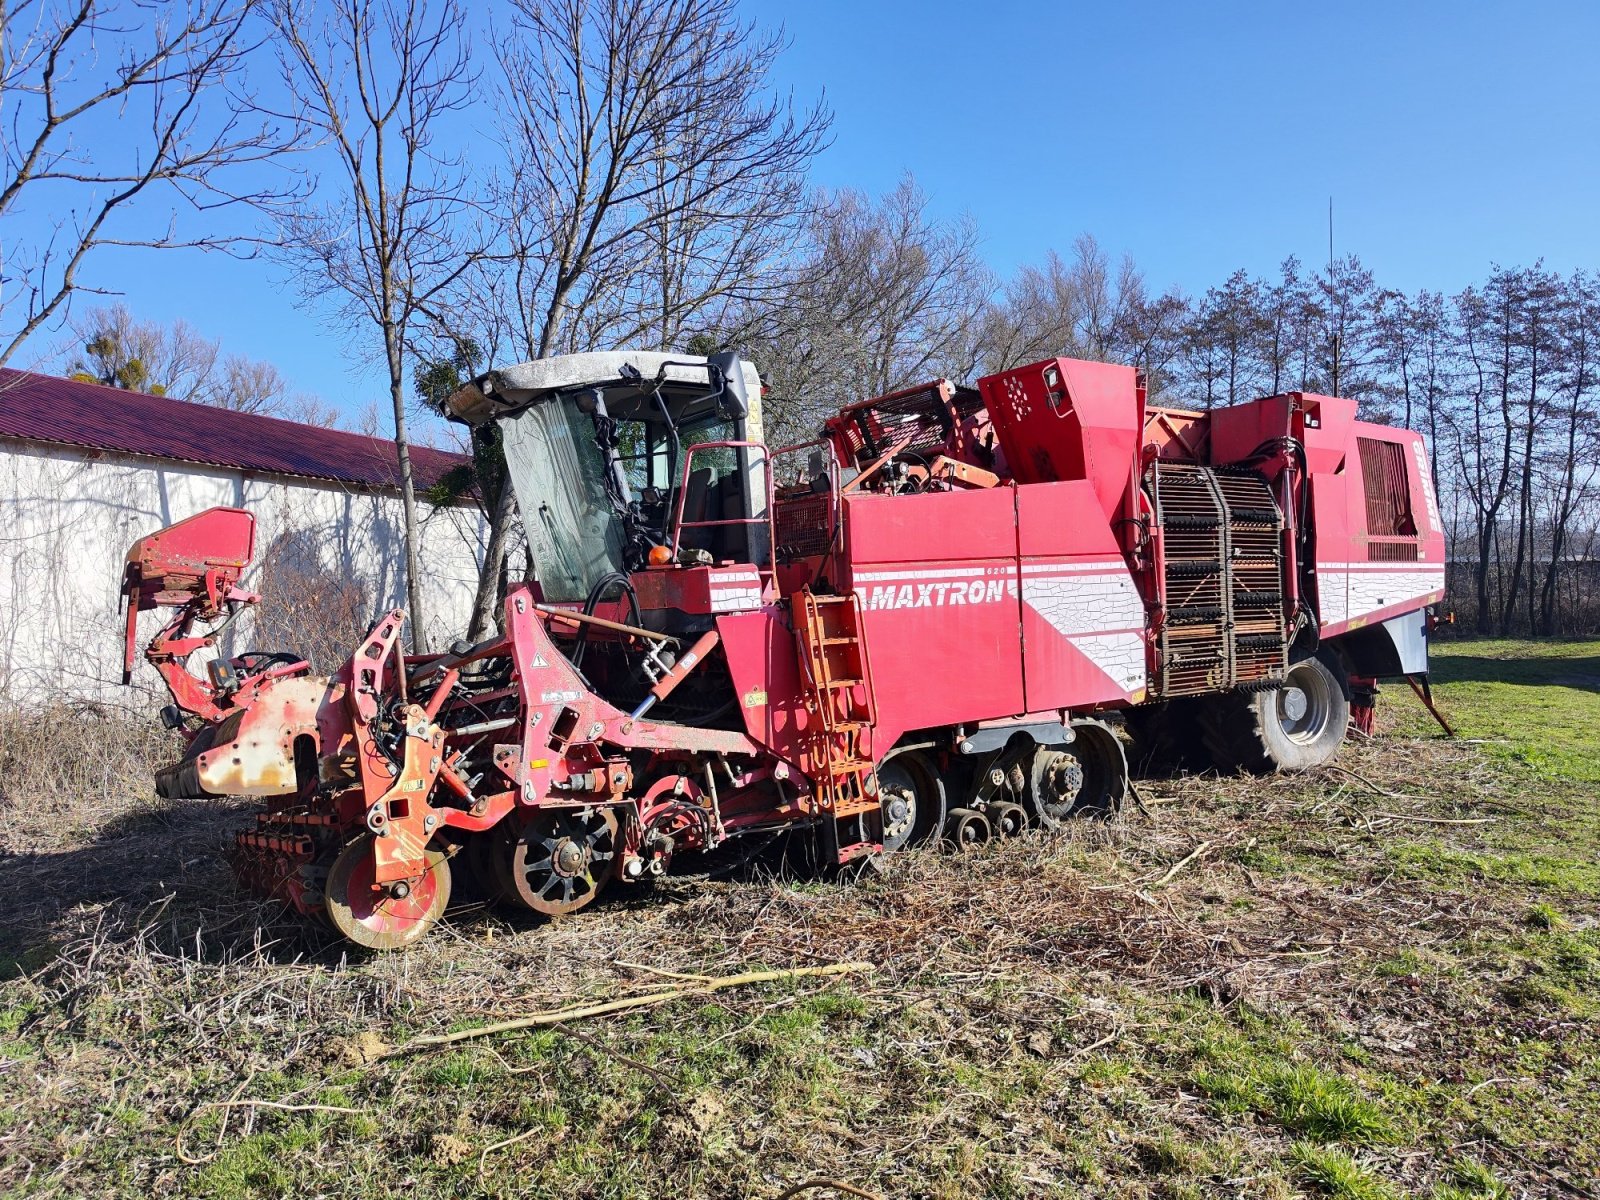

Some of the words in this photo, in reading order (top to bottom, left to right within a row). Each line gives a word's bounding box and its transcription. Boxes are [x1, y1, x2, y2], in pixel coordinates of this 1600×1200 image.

[1412, 440, 1438, 533] GRIMME
[987, 567, 1005, 575] 620
[870, 579, 1005, 611] MAXTRON
